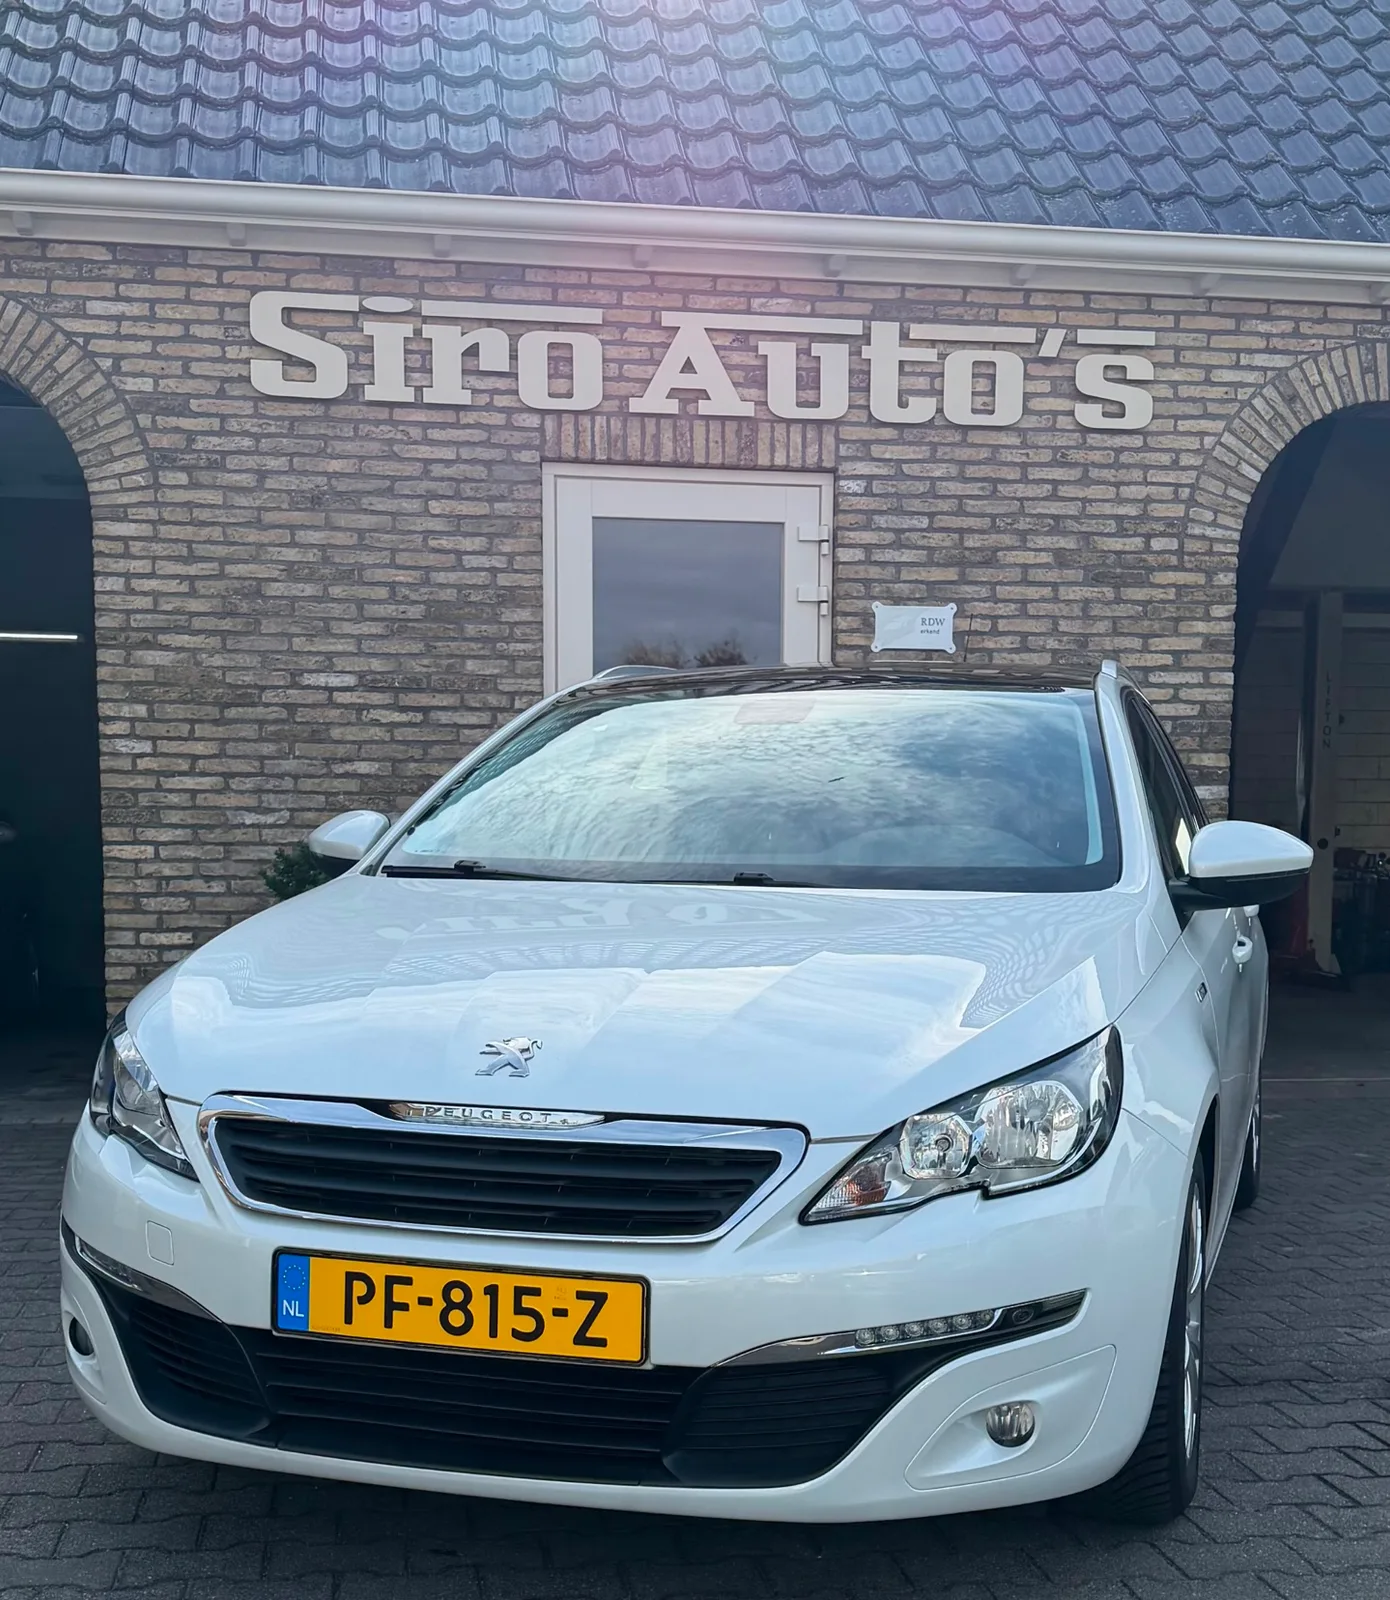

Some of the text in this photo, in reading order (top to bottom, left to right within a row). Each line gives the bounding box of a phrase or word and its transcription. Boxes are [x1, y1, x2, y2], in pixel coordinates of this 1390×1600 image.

[249, 290, 1156, 430] Siro Auto's
[920, 617, 946, 626] RDW
[1322, 669, 1333, 749] LIFTON
[424, 1105, 552, 1123] PEUGEOT
[282, 1300, 304, 1318] NL
[344, 1270, 609, 1348] PF-815-Z
